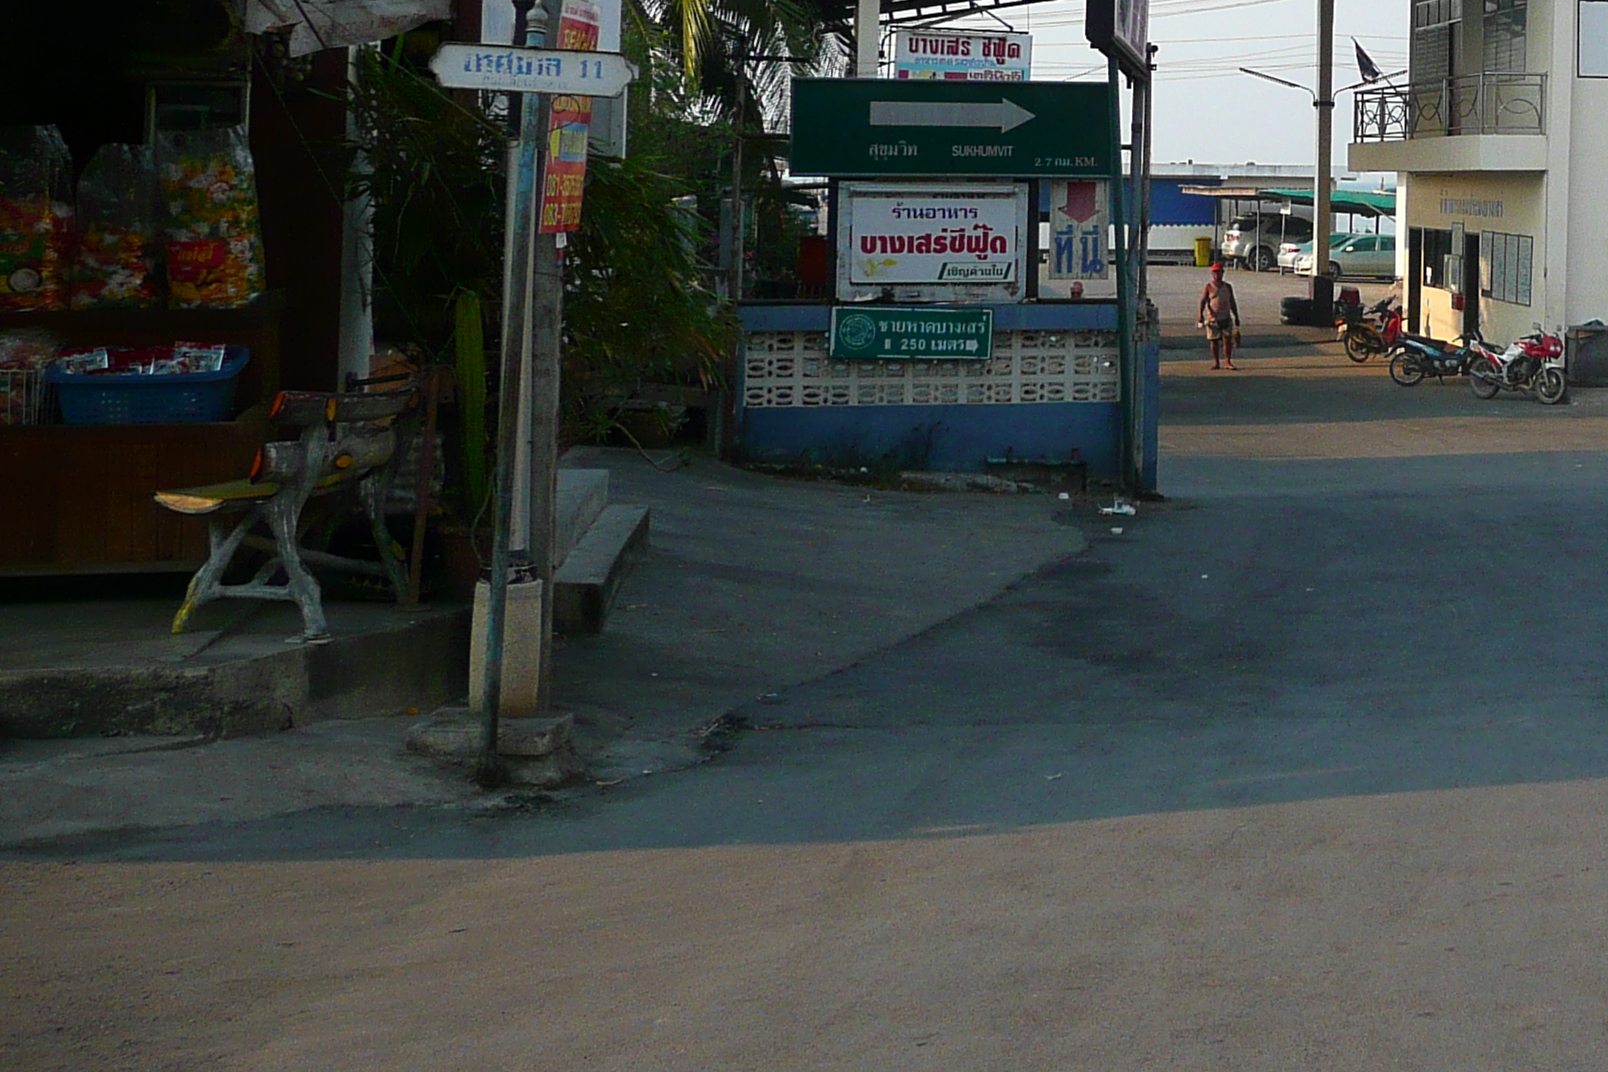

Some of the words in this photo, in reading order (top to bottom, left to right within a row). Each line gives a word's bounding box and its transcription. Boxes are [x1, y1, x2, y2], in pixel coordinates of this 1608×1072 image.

[951, 144, 1014, 157] SUKHUMVIT
[891, 202, 979, 220] ร้านอาหาร
[900, 338, 927, 351] 250
